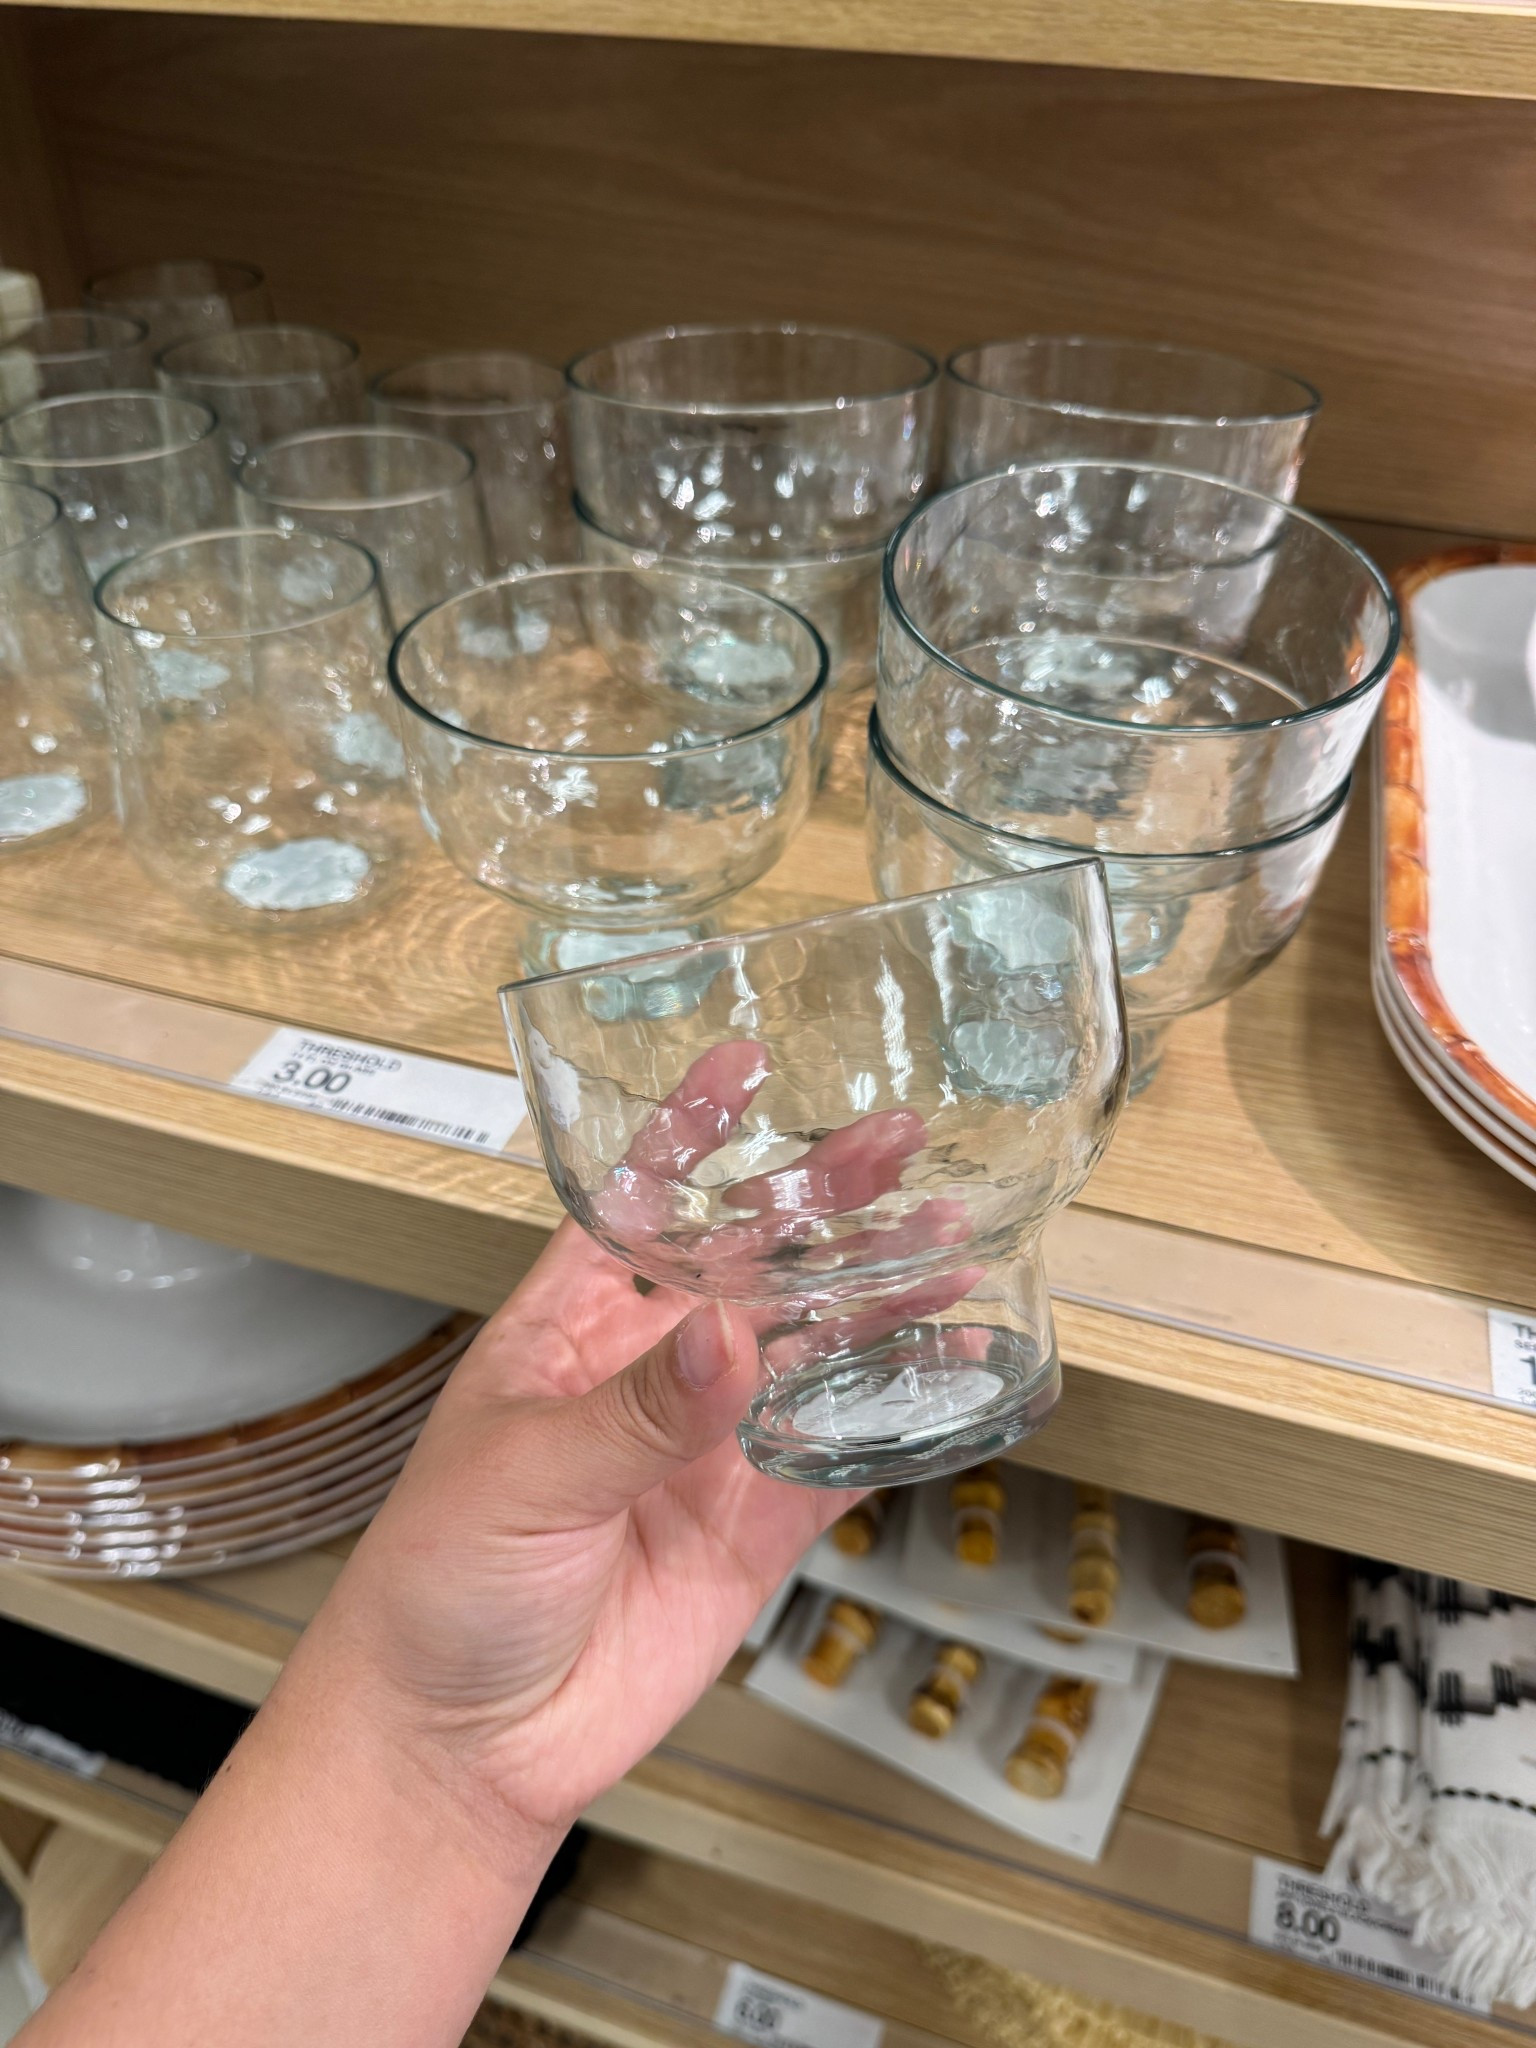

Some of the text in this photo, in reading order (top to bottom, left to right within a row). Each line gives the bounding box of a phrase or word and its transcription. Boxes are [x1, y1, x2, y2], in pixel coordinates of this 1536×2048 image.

[299, 1038, 402, 1072] THRESHOLD
[273, 1060, 352, 1094] 3.00
[1275, 1901, 1341, 1945] 8.00
